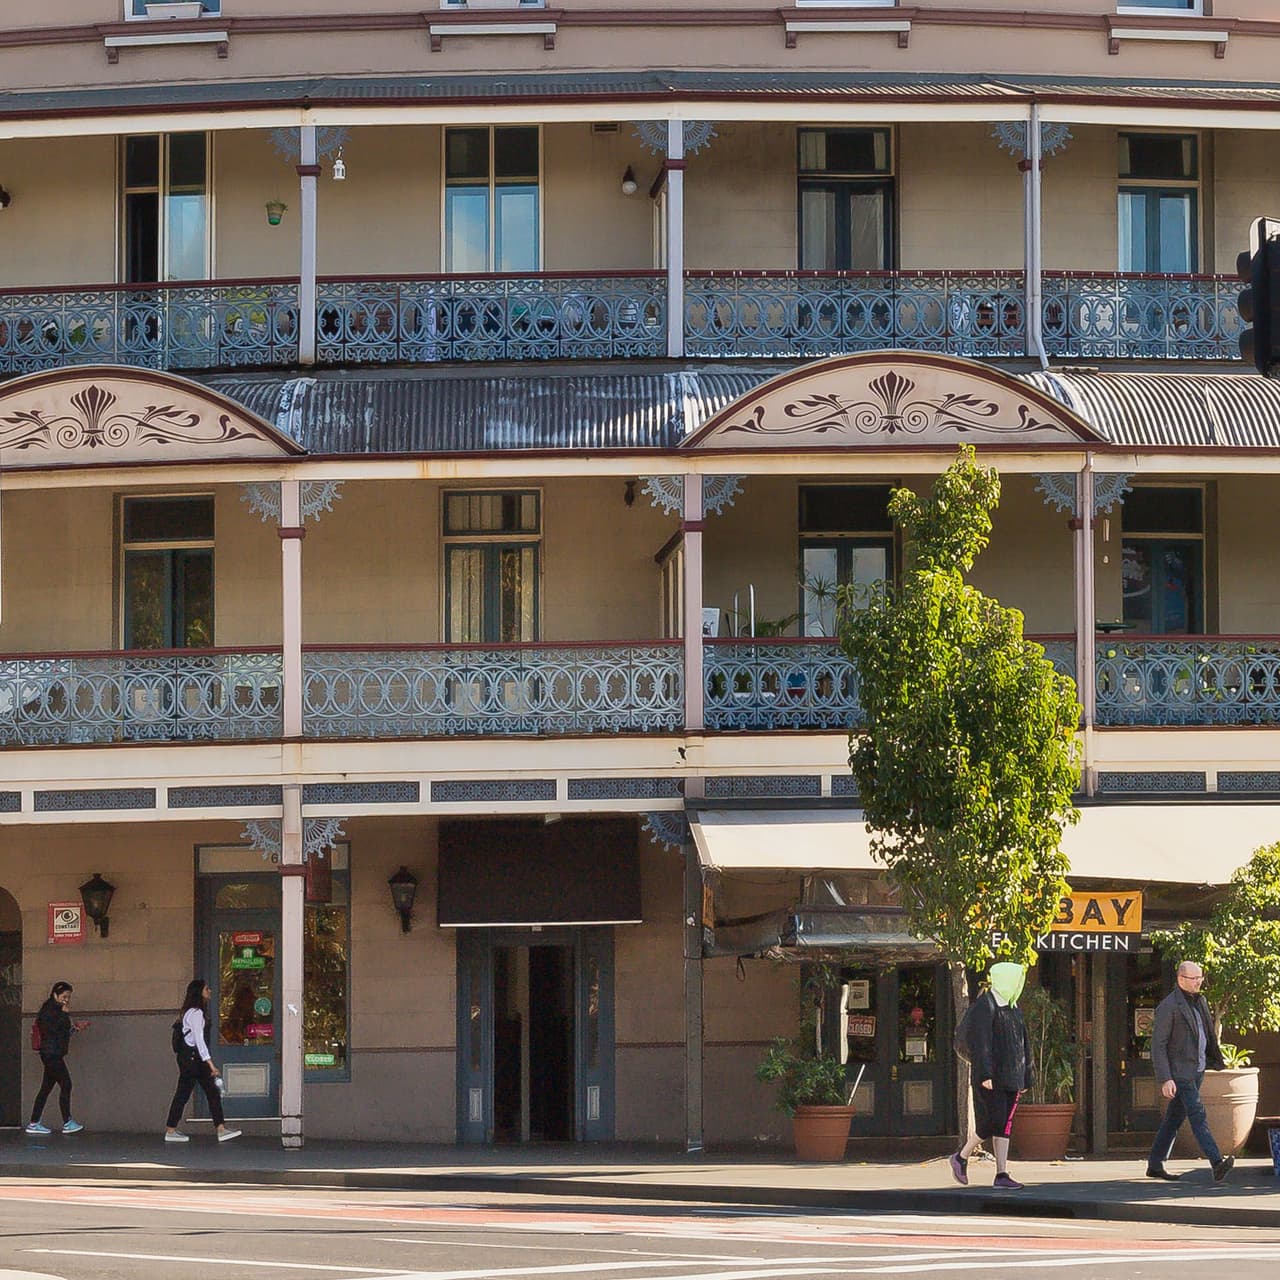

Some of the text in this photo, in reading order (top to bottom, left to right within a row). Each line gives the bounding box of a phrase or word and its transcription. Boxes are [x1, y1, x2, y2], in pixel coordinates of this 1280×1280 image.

[1054, 898, 1134, 926] BAY
[1036, 932, 1129, 950] KITCHEN
[847, 1023, 872, 1035] CLOSED
